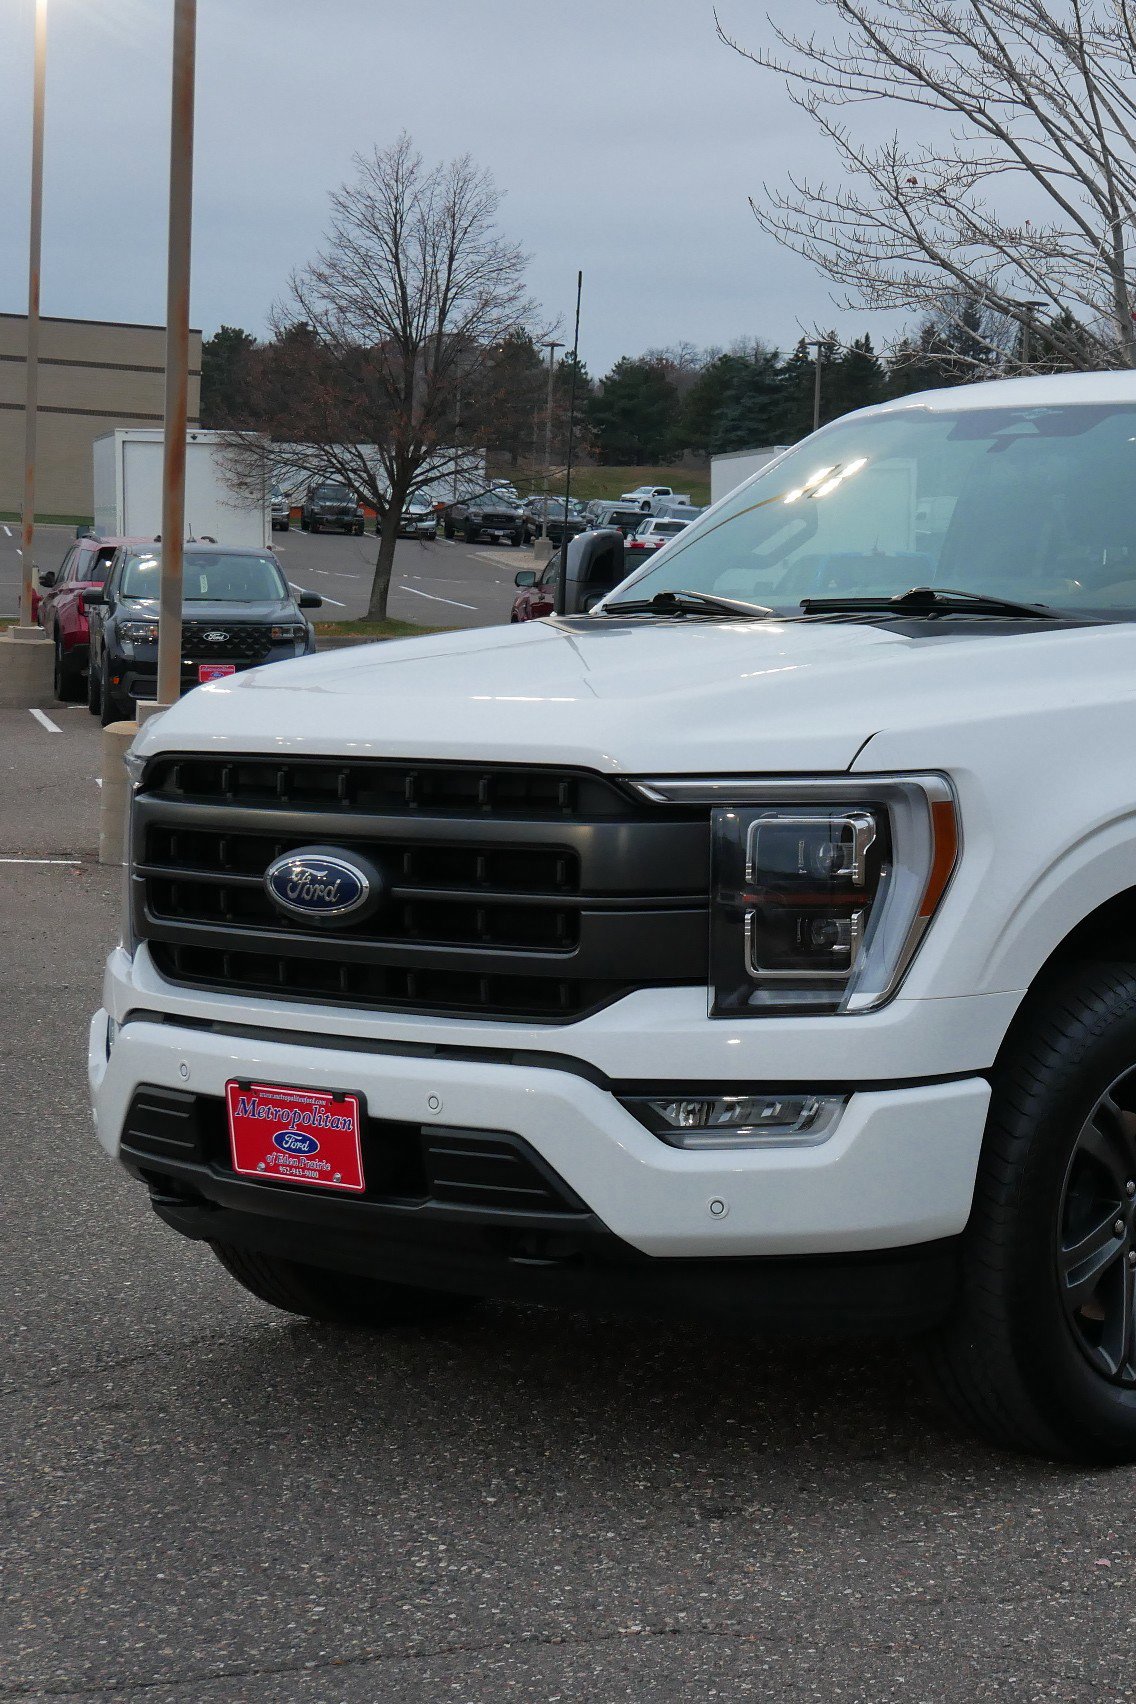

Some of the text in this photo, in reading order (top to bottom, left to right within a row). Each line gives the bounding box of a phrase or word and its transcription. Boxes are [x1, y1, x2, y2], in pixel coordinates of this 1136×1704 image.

[286, 867, 341, 902] Ford
[235, 1097, 353, 1131] Metropolitan
[282, 1133, 310, 1151] Ford
[266, 1152, 331, 1171] of Eden Prairie
